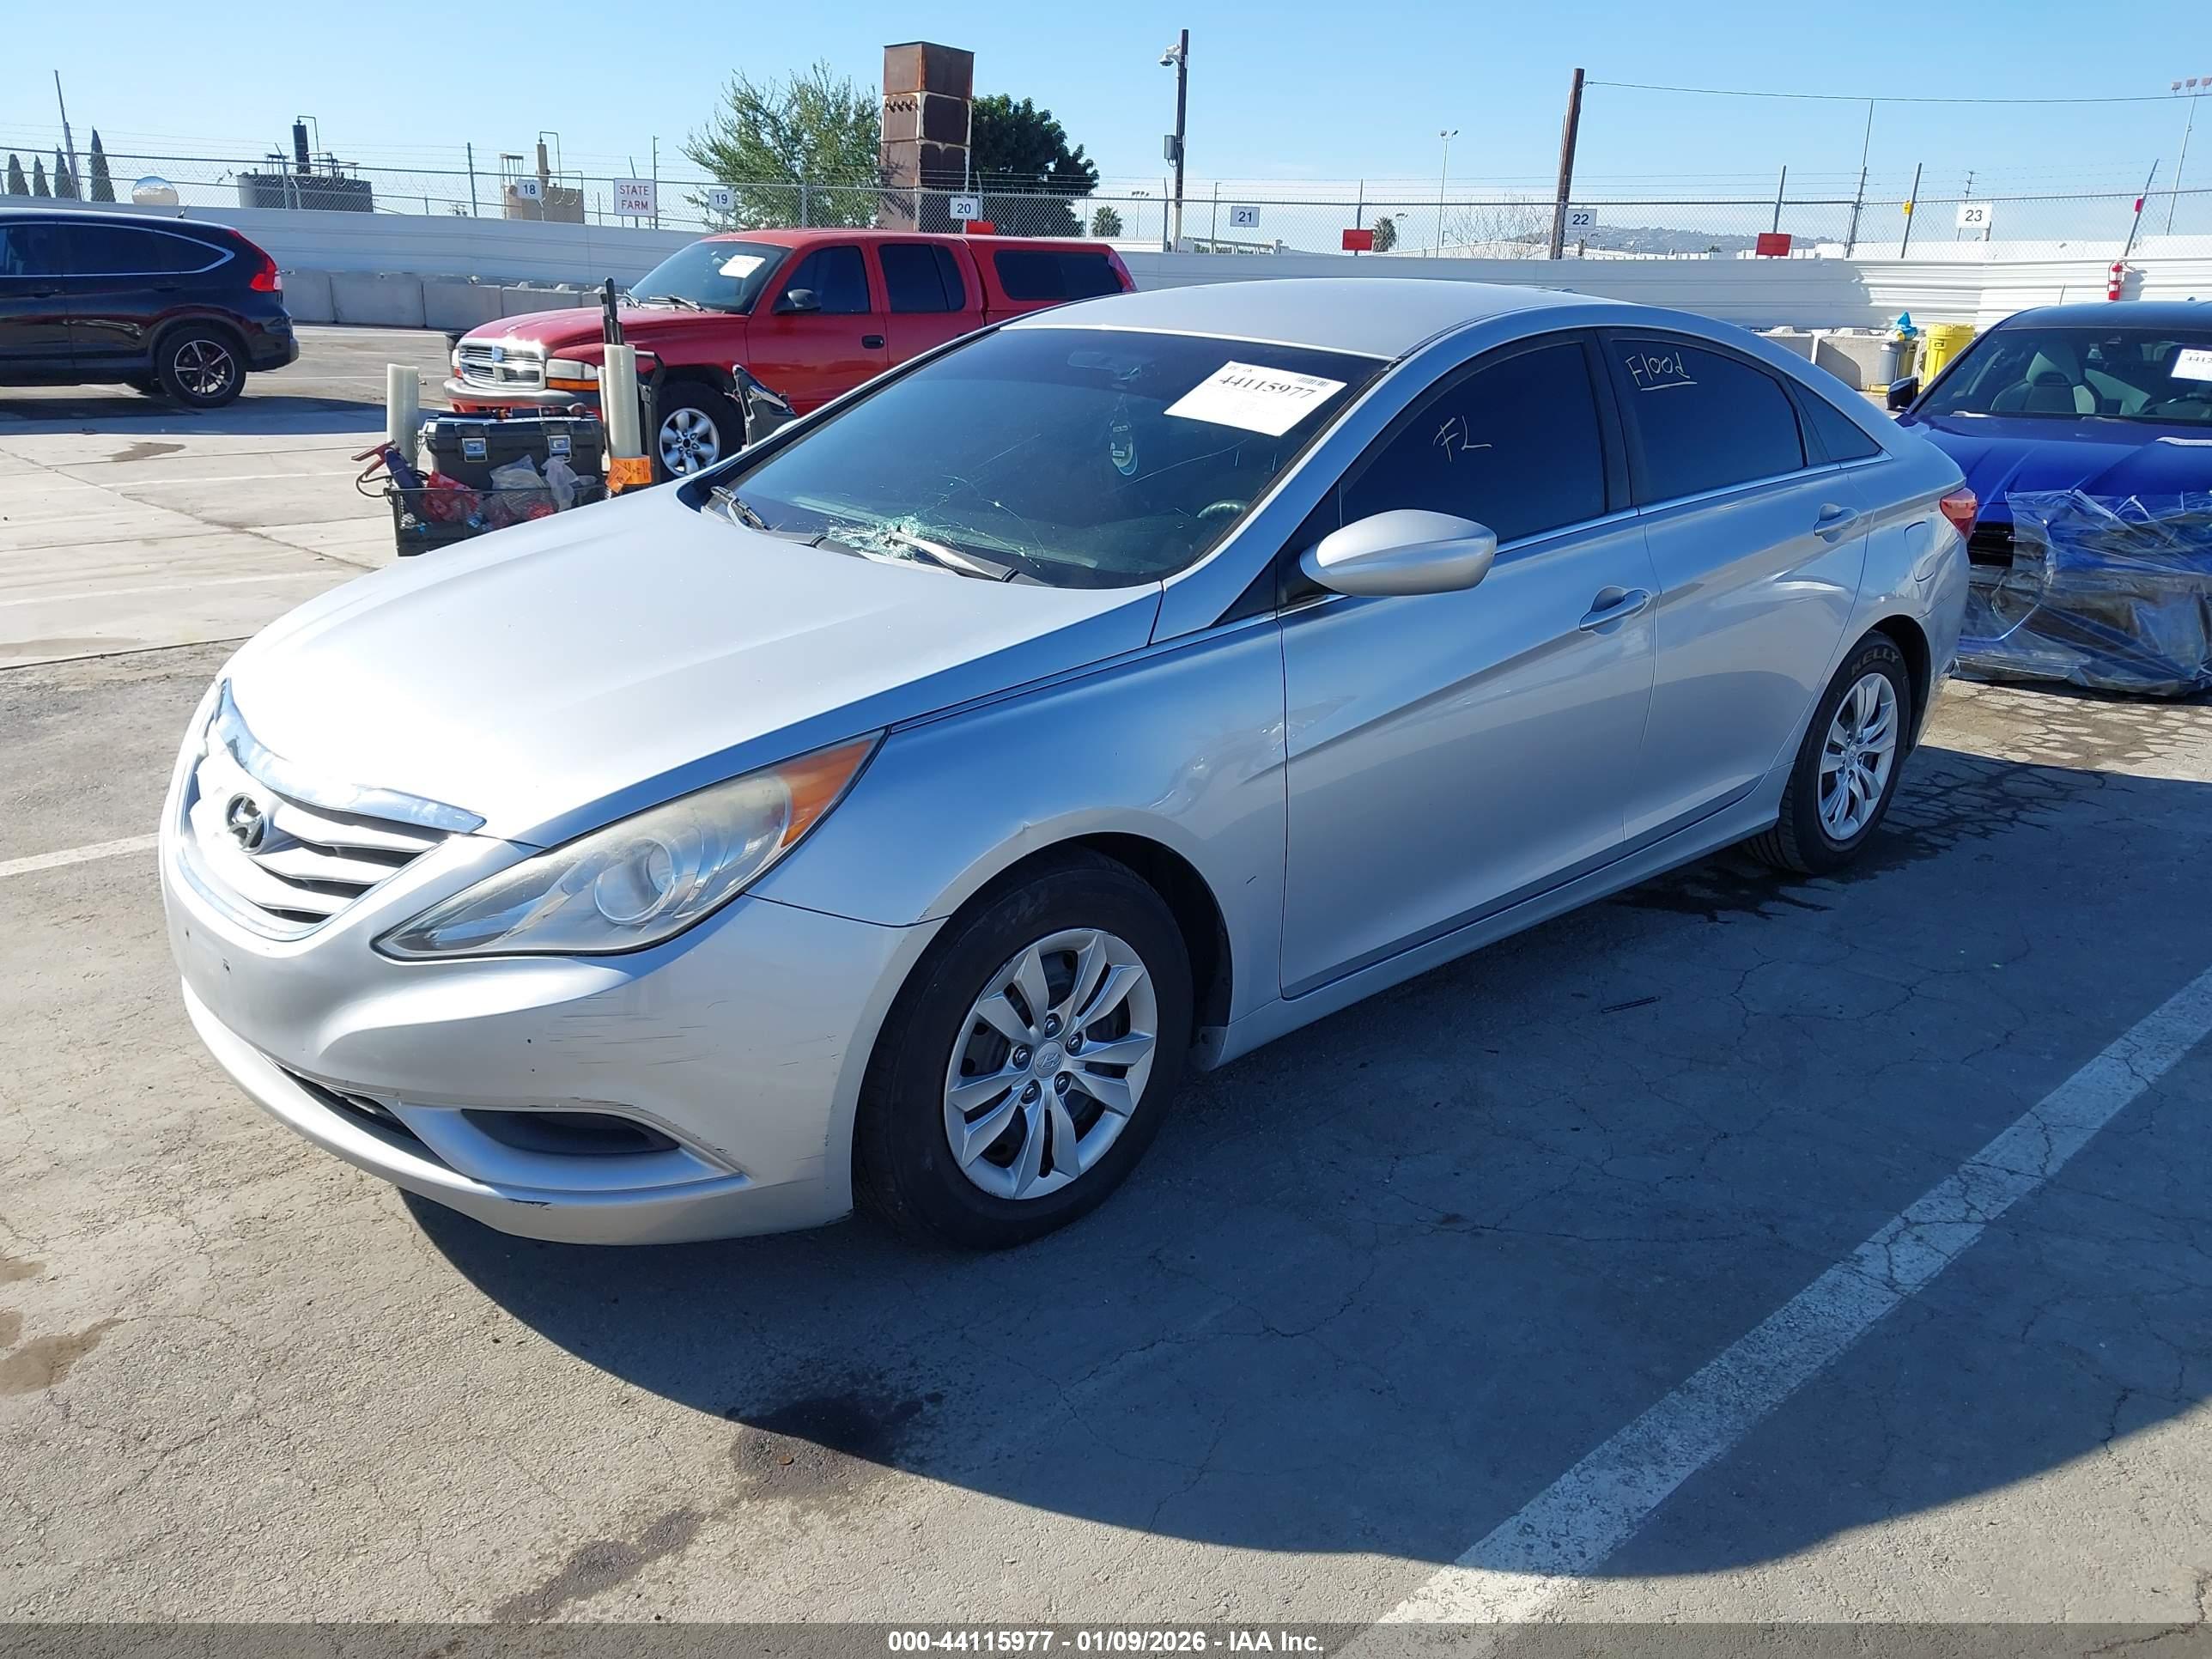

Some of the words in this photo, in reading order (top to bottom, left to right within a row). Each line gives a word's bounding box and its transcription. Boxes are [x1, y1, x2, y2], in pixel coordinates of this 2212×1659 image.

[523, 184, 536, 195] 18
[619, 185, 649, 196] STATE
[621, 199, 648, 210] FARM
[715, 194, 728, 204] 19
[957, 203, 971, 214] 20
[1238, 211, 1252, 222] 21
[1572, 214, 1589, 225] 22
[1965, 210, 1983, 222] 23
[1219, 375, 1317, 398] 44115977
[1850, 647, 1899, 677] KELLY
